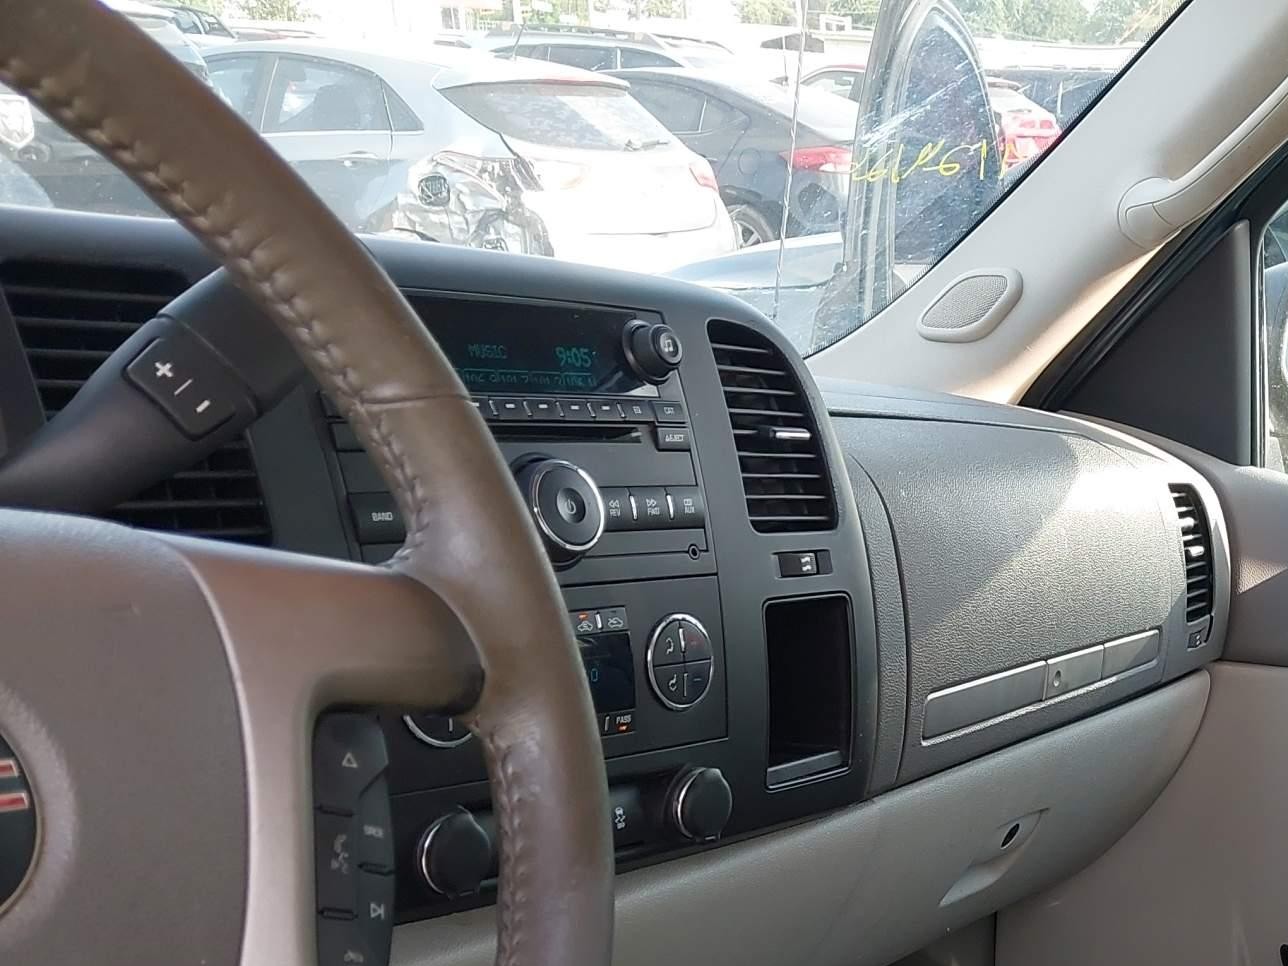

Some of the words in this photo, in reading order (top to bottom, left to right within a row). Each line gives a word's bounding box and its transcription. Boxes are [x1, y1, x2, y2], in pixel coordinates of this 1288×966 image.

[467, 344, 508, 360] MUSIC
[555, 346, 592, 367] 9:05
[371, 511, 393, 522] BAND
[616, 714, 632, 724] PASS
